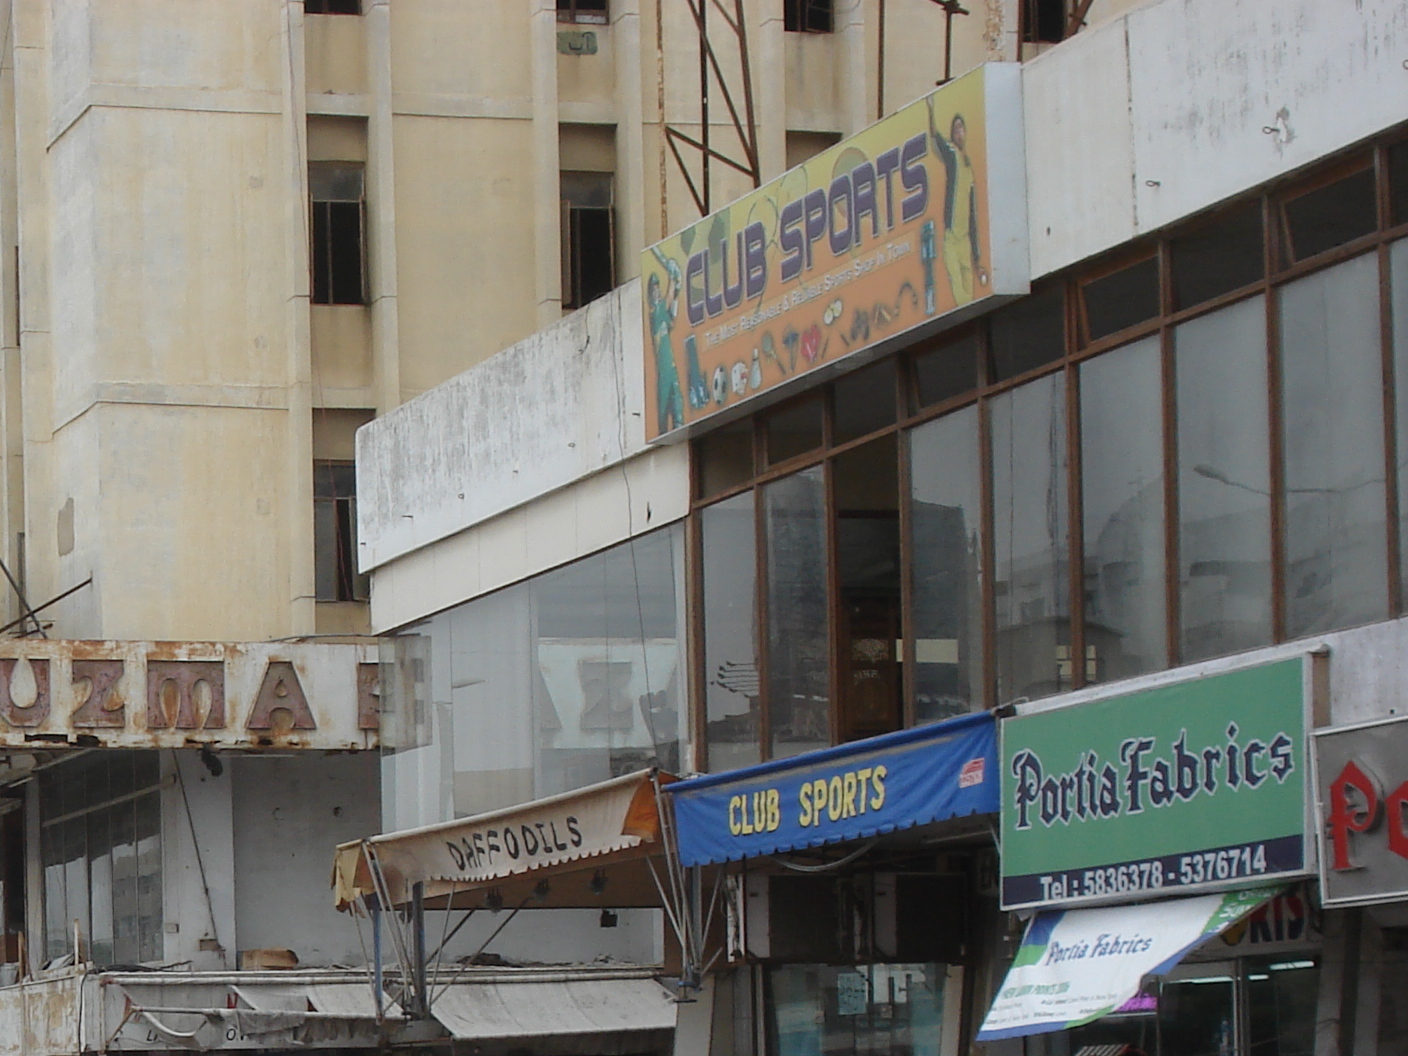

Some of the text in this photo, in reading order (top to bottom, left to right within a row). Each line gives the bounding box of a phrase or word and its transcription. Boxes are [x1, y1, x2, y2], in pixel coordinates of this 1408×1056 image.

[685, 132, 929, 327] CLUB SPORTS
[728, 766, 886, 837] CLUB SPORTS
[1012, 720, 1294, 830] Portia Fabrics
[446, 815, 583, 872] DAFFODILS
[1083, 860, 1164, 896] 5836378
[1180, 845, 1268, 885] 5376714
[1045, 932, 1153, 966] Portia Fabrics
